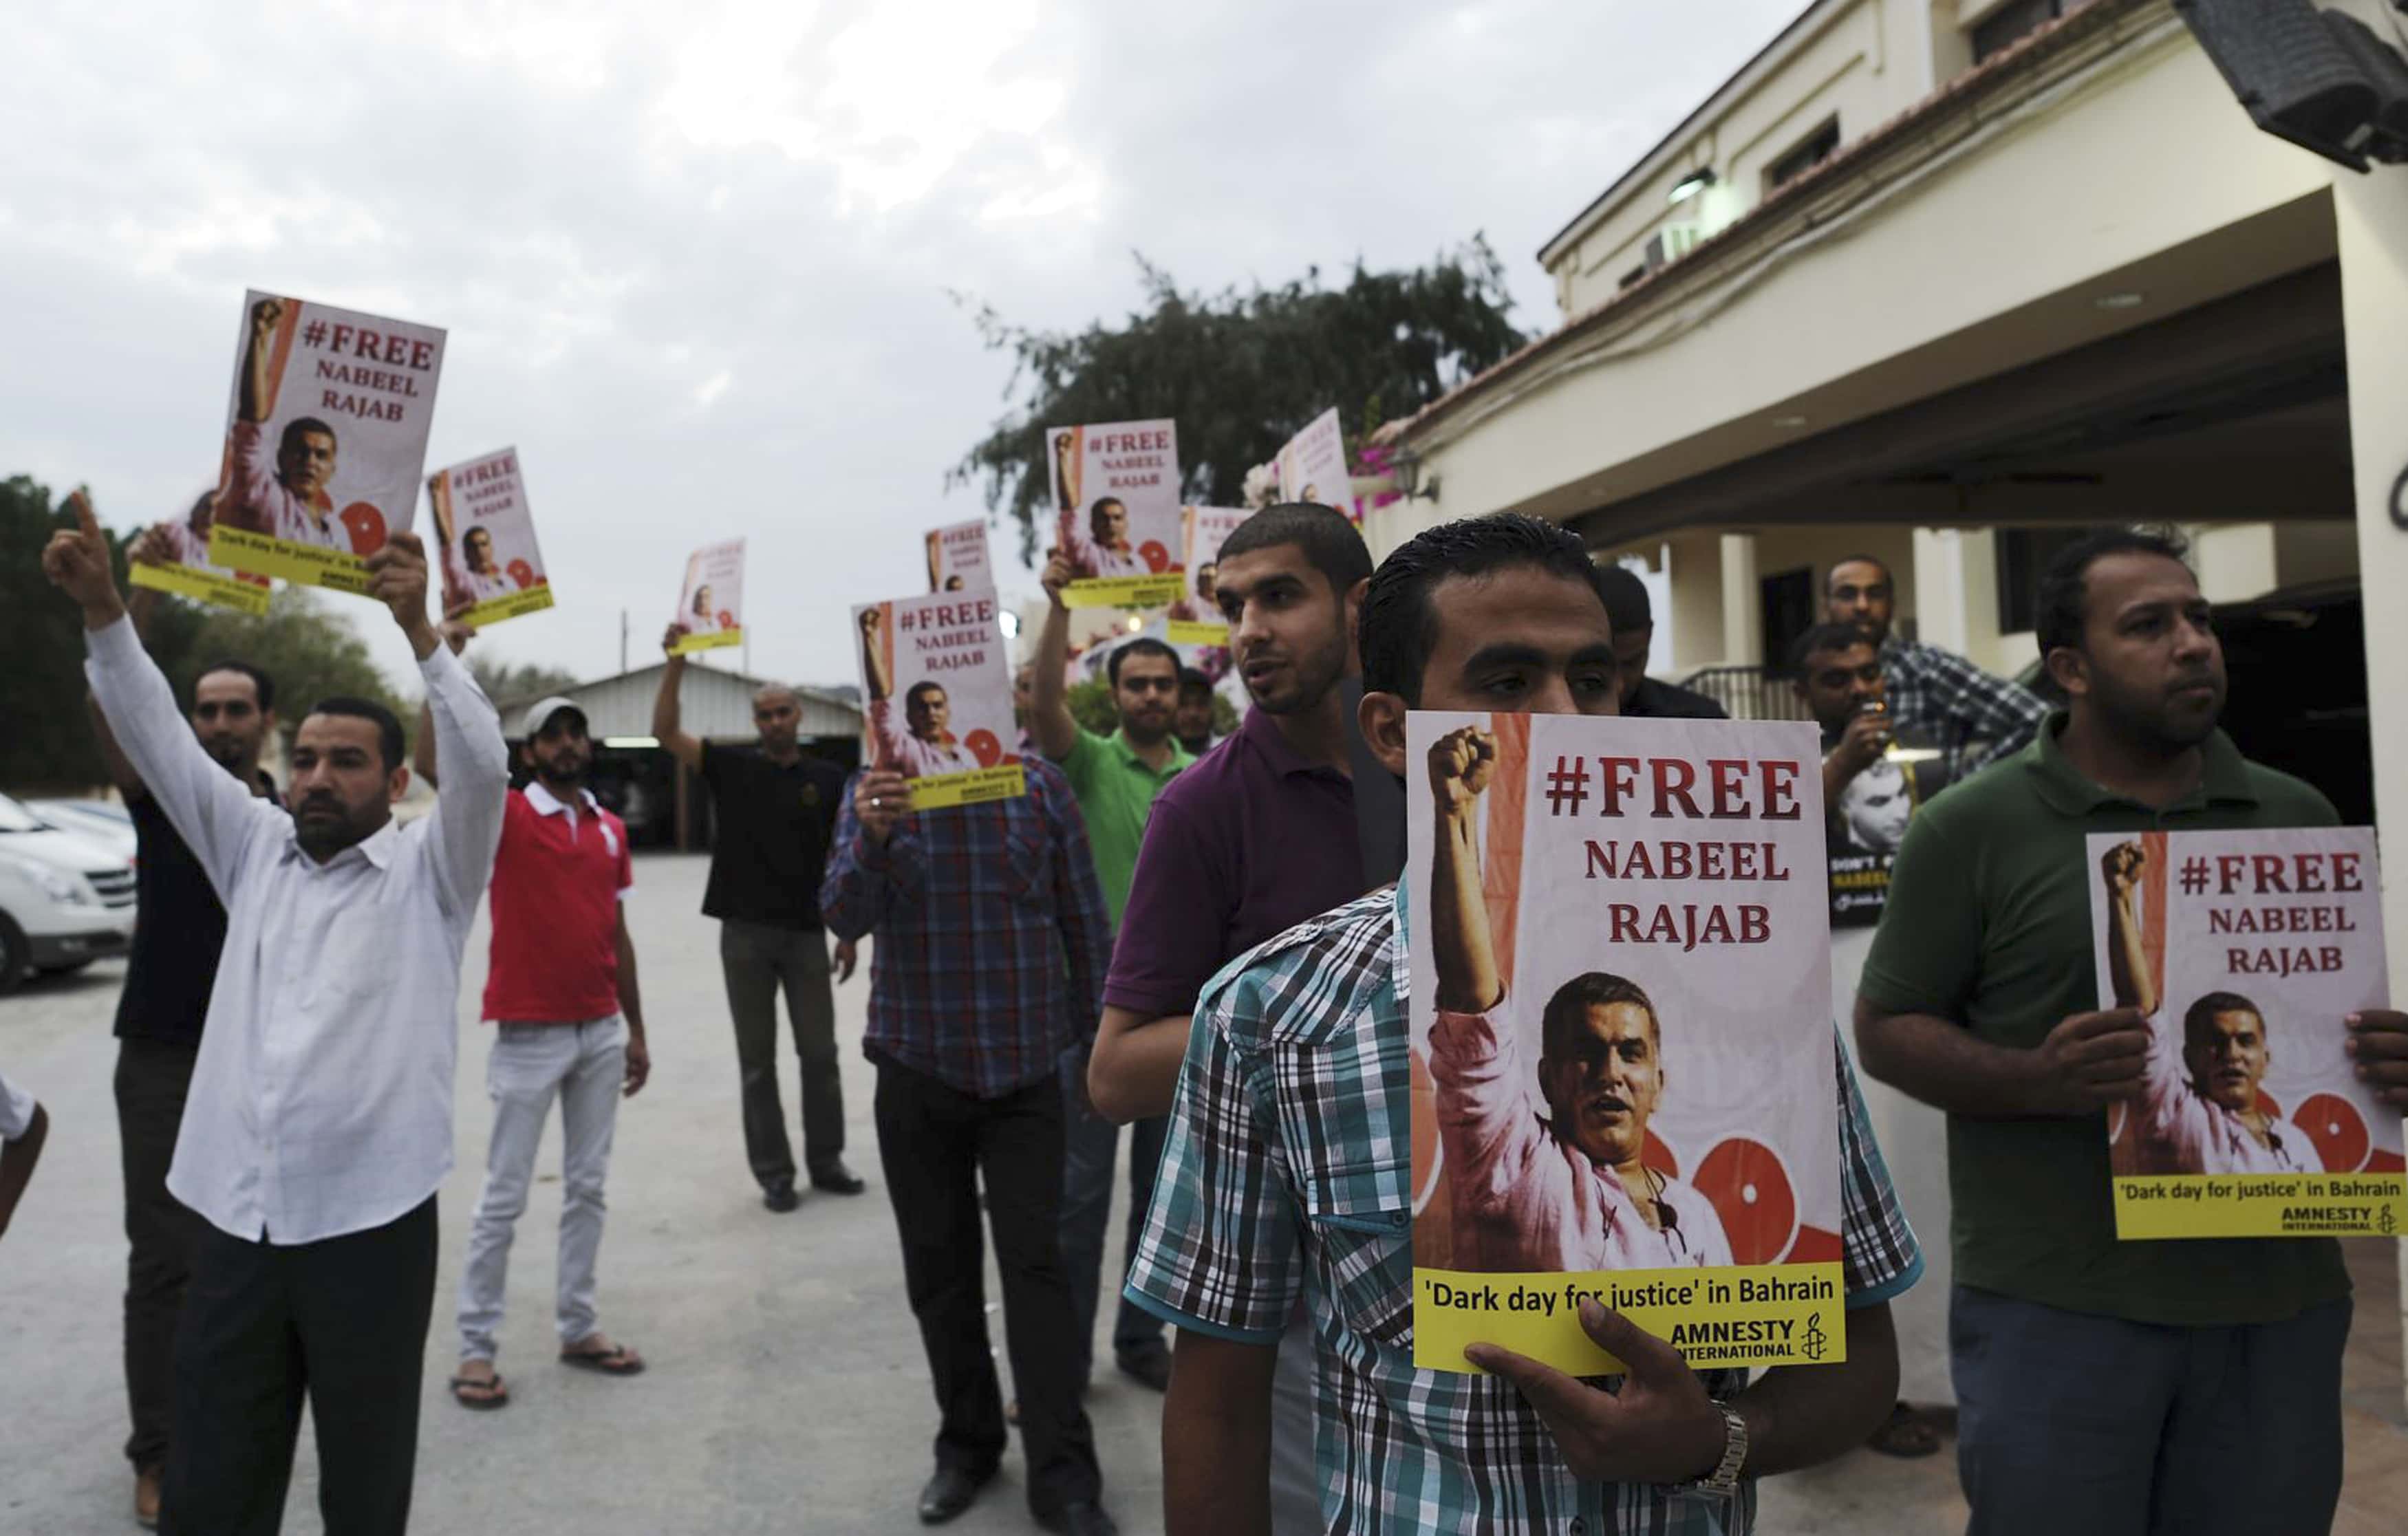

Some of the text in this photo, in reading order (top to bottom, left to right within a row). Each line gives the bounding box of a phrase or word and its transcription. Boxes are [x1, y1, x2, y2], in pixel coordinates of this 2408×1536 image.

[303, 318, 435, 371] #FREE
[316, 358, 418, 398] NABEEL
[321, 389, 405, 423] RAJAB
[1089, 430, 1170, 453] #FREE
[454, 455, 514, 488] #FREE
[901, 599, 993, 632] #FREE
[915, 629, 991, 651] NABEEL
[925, 650, 985, 672] RAJAB
[1546, 755, 1800, 820] #FREE
[1584, 840, 1789, 880] NABEEL
[2180, 852, 2363, 895] #FREE
[1609, 904, 1771, 953] RAJAB
[2208, 906, 2356, 934] NABEEL
[2227, 947, 2343, 978] RAJAB
[2120, 1180, 2400, 1202] 'Dark day for justice' in Bahrain
[2281, 1207, 2372, 1221] AMNESTY
[2281, 1222, 2372, 1231] INTERNATIONAL
[1426, 1280, 1499, 1310] 'Dark
[1508, 1285, 1557, 1317] day
[1611, 1279, 1699, 1310] justice'
[1708, 1279, 1730, 1304] in
[1739, 1275, 1834, 1302] Bahrain
[1671, 1319, 1794, 1345] AMNESTY
[1677, 1344, 1795, 1361] NTERNATIONAL
